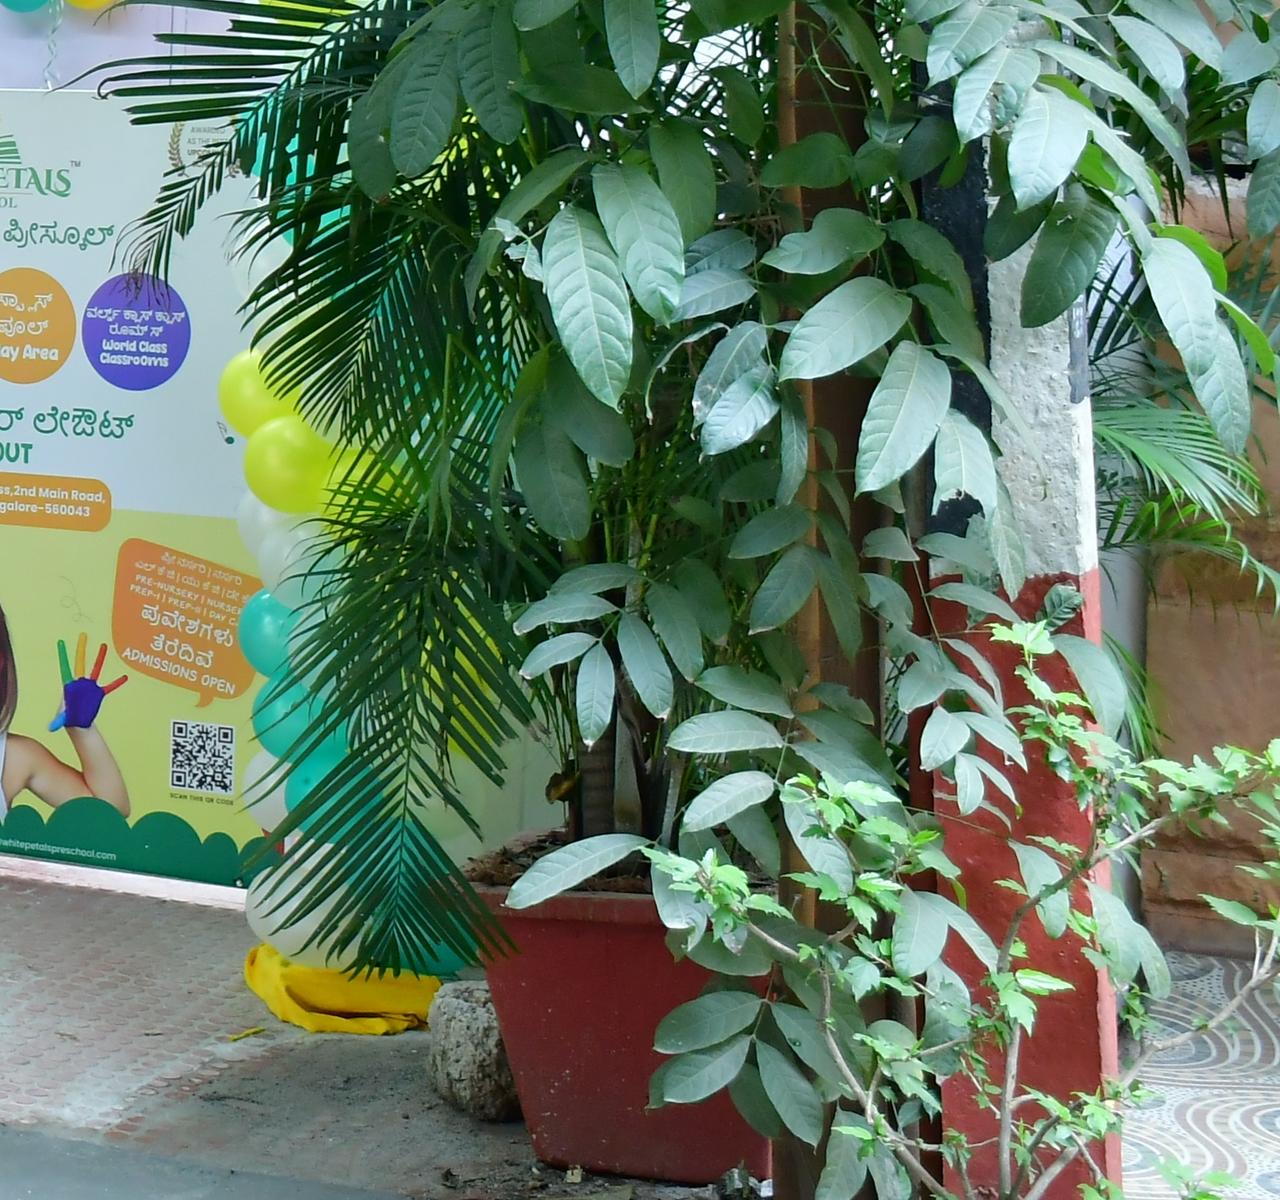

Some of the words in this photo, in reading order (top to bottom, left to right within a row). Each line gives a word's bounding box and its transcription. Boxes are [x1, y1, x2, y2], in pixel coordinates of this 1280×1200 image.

[22, 344, 58, 361] Area
[102, 339, 136, 352] World
[140, 340, 168, 354] Class
[39, 488, 68, 500] Main
[71, 491, 106, 505] Road,
[136, 574, 200, 601] PRE-NURSERY
[122, 647, 197, 682] ADMISSIONS
[201, 674, 236, 695] OPEN
